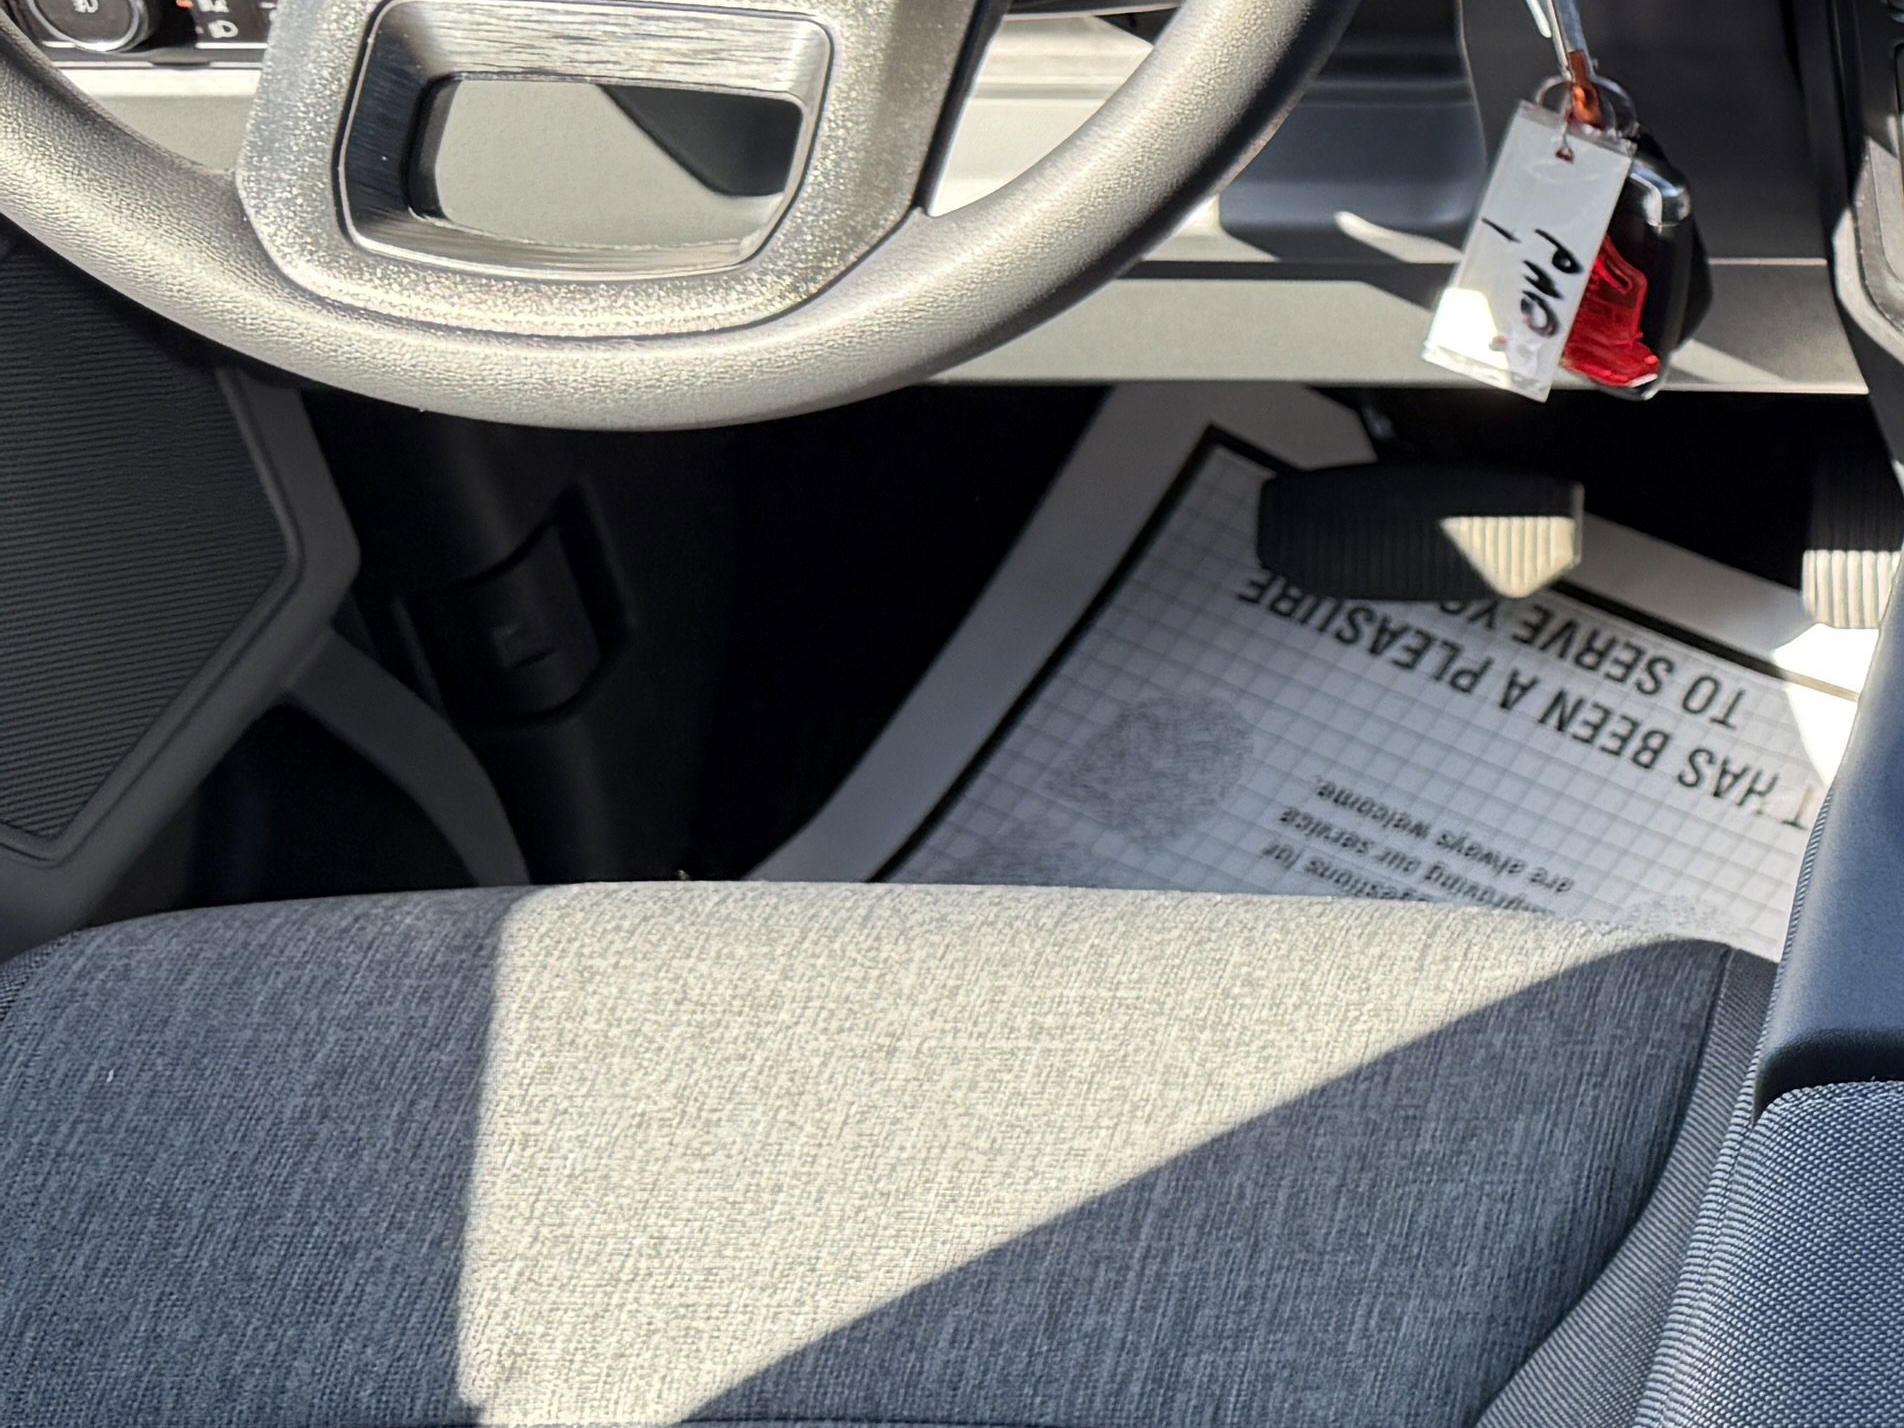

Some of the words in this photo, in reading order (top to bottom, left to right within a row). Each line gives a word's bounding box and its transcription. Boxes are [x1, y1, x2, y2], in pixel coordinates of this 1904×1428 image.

[1236, 572, 1495, 695] PLEASURE
[1511, 603, 1675, 696] SERVE
[1498, 667, 1541, 711] A
[1681, 674, 1746, 730] TO
[1537, 686, 1674, 770] BEEN
[1676, 747, 1781, 815] HAS
[1279, 805, 1377, 855] service
[1434, 828, 1527, 878] always
[1375, 847, 1421, 874] our
[1528, 865, 1576, 894] are
